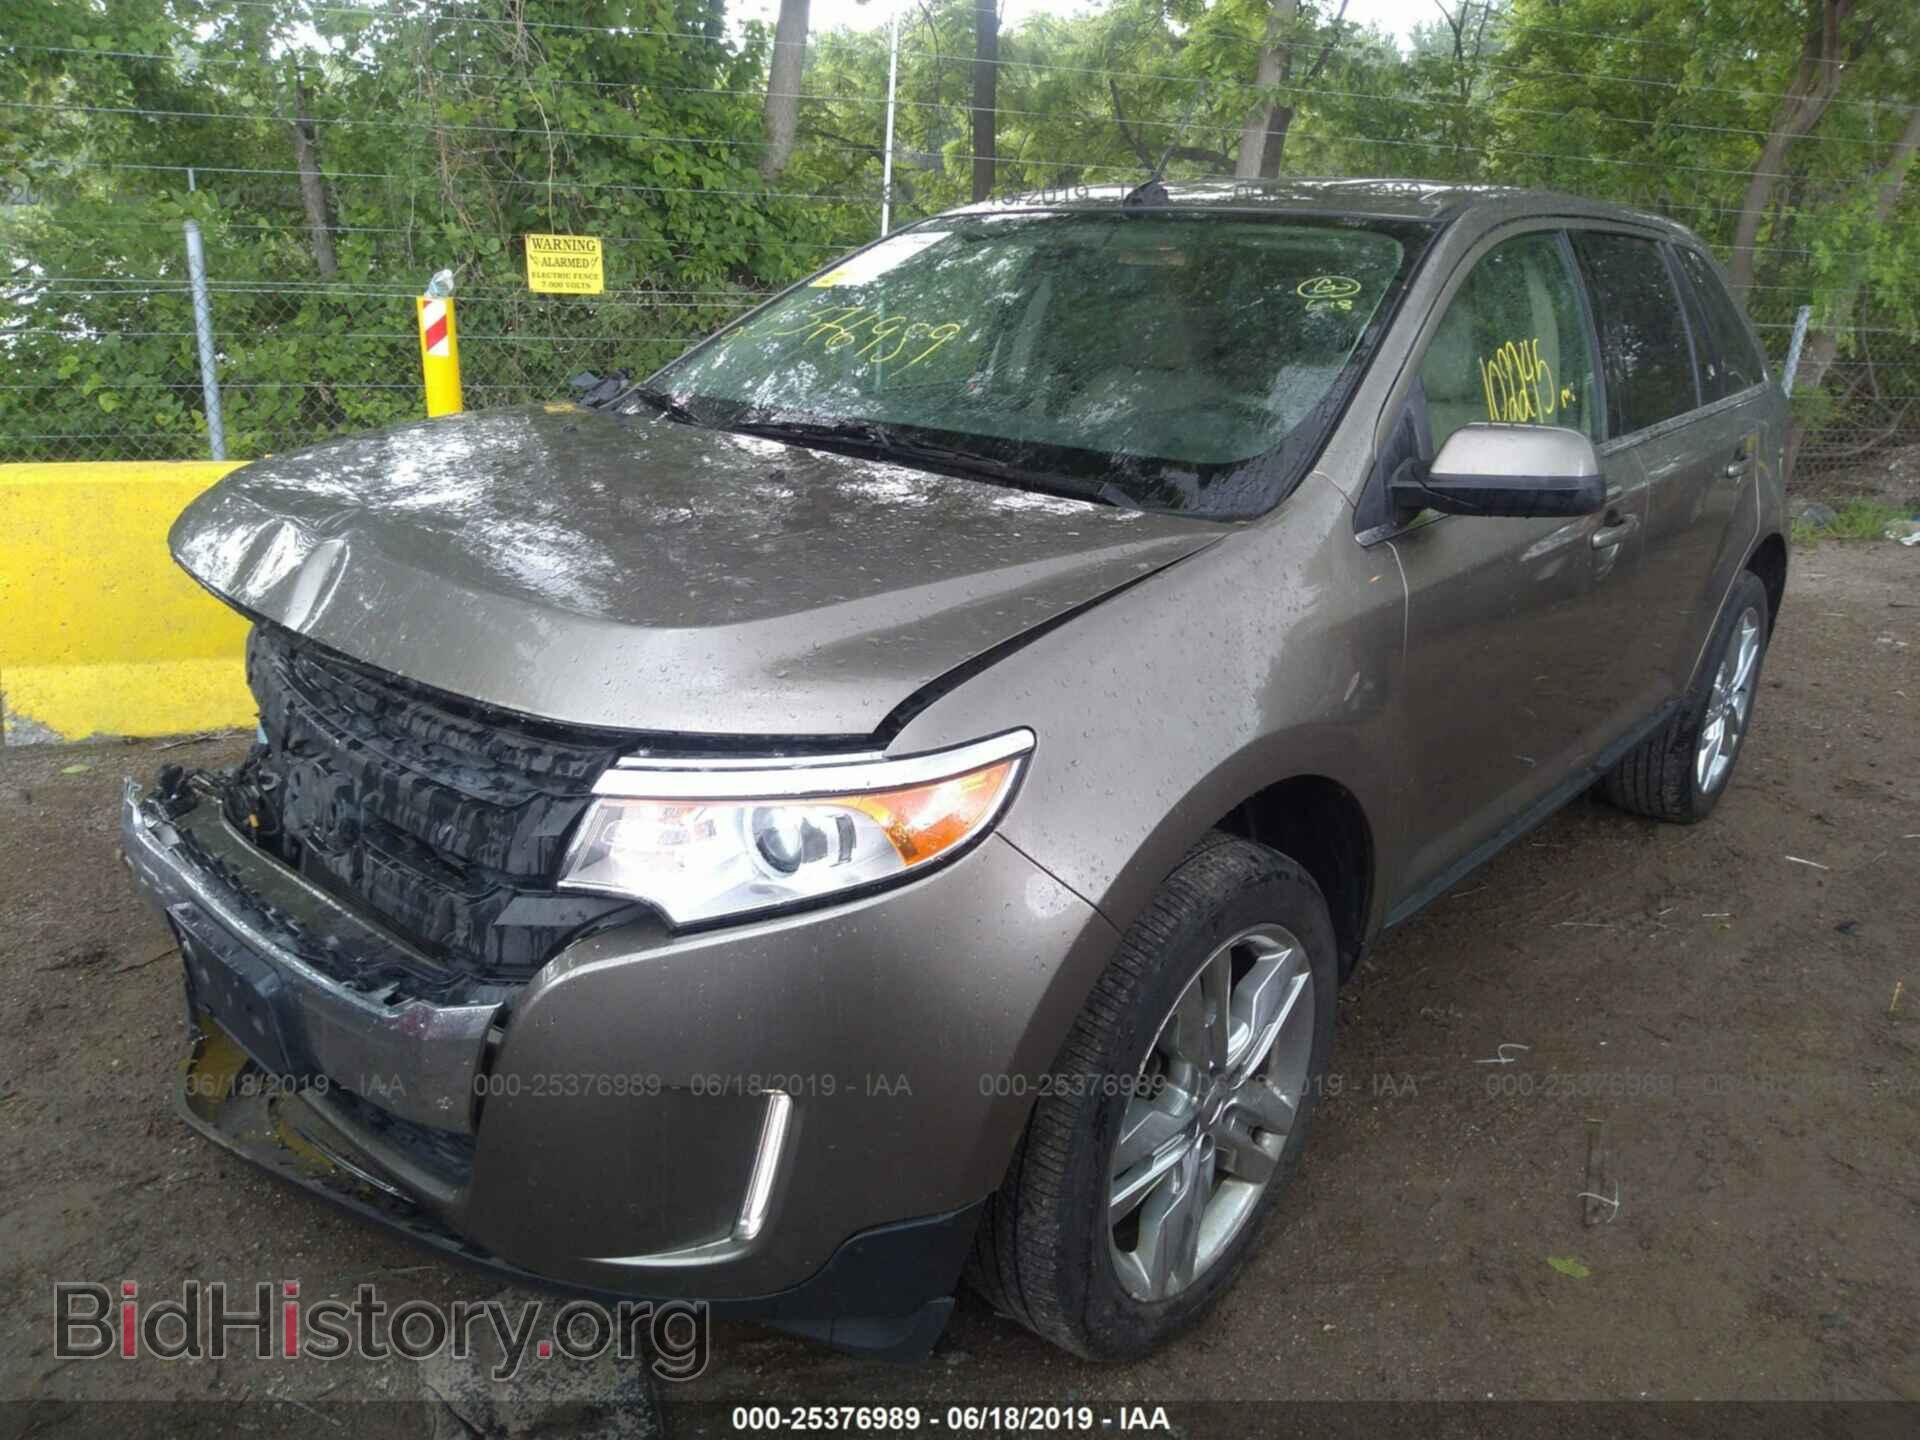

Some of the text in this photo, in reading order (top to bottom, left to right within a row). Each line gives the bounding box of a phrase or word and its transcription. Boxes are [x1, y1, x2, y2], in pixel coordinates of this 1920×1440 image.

[532, 238, 596, 252] WARNING
[541, 257, 590, 269] ALARMED
[532, 272, 600, 280] ELECTRIC FENCE
